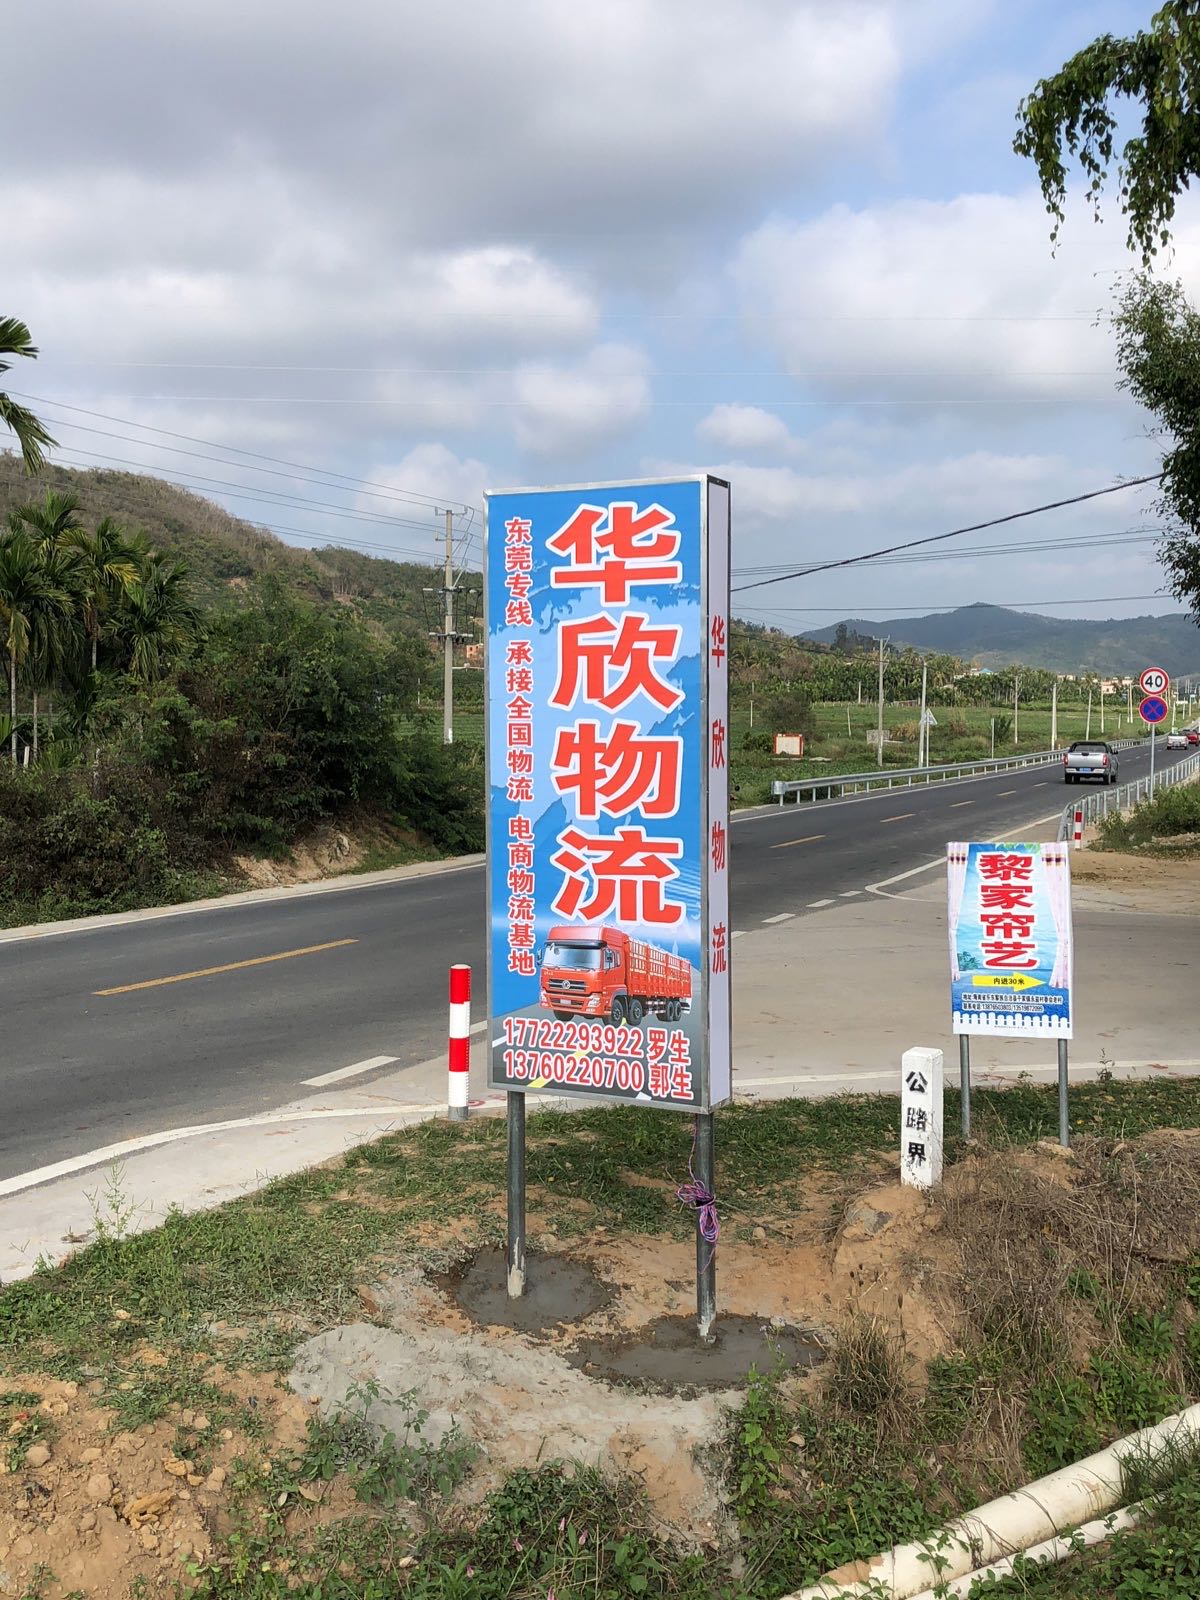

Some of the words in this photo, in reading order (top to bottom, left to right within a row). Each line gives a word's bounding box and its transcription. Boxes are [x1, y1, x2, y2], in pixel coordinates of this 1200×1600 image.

[505, 517, 533, 626] 东莞专线
[505, 640, 533, 801] 承接全国物流
[548, 503, 683, 924] 华欣物流
[1145, 675, 1163, 688] 40
[711, 615, 727, 974] 华欣物流
[508, 816, 535, 975] 电商物流基地
[978, 853, 1038, 969] 黎家帘艺
[993, 977, 1025, 985] 内进30米
[503, 1018, 643, 1057] 17722293922
[648, 1029, 691, 1065] 罗生
[503, 1050, 644, 1090] 13760220700
[650, 1063, 694, 1099] 郭生
[905, 1071, 928, 1167] 公路界
